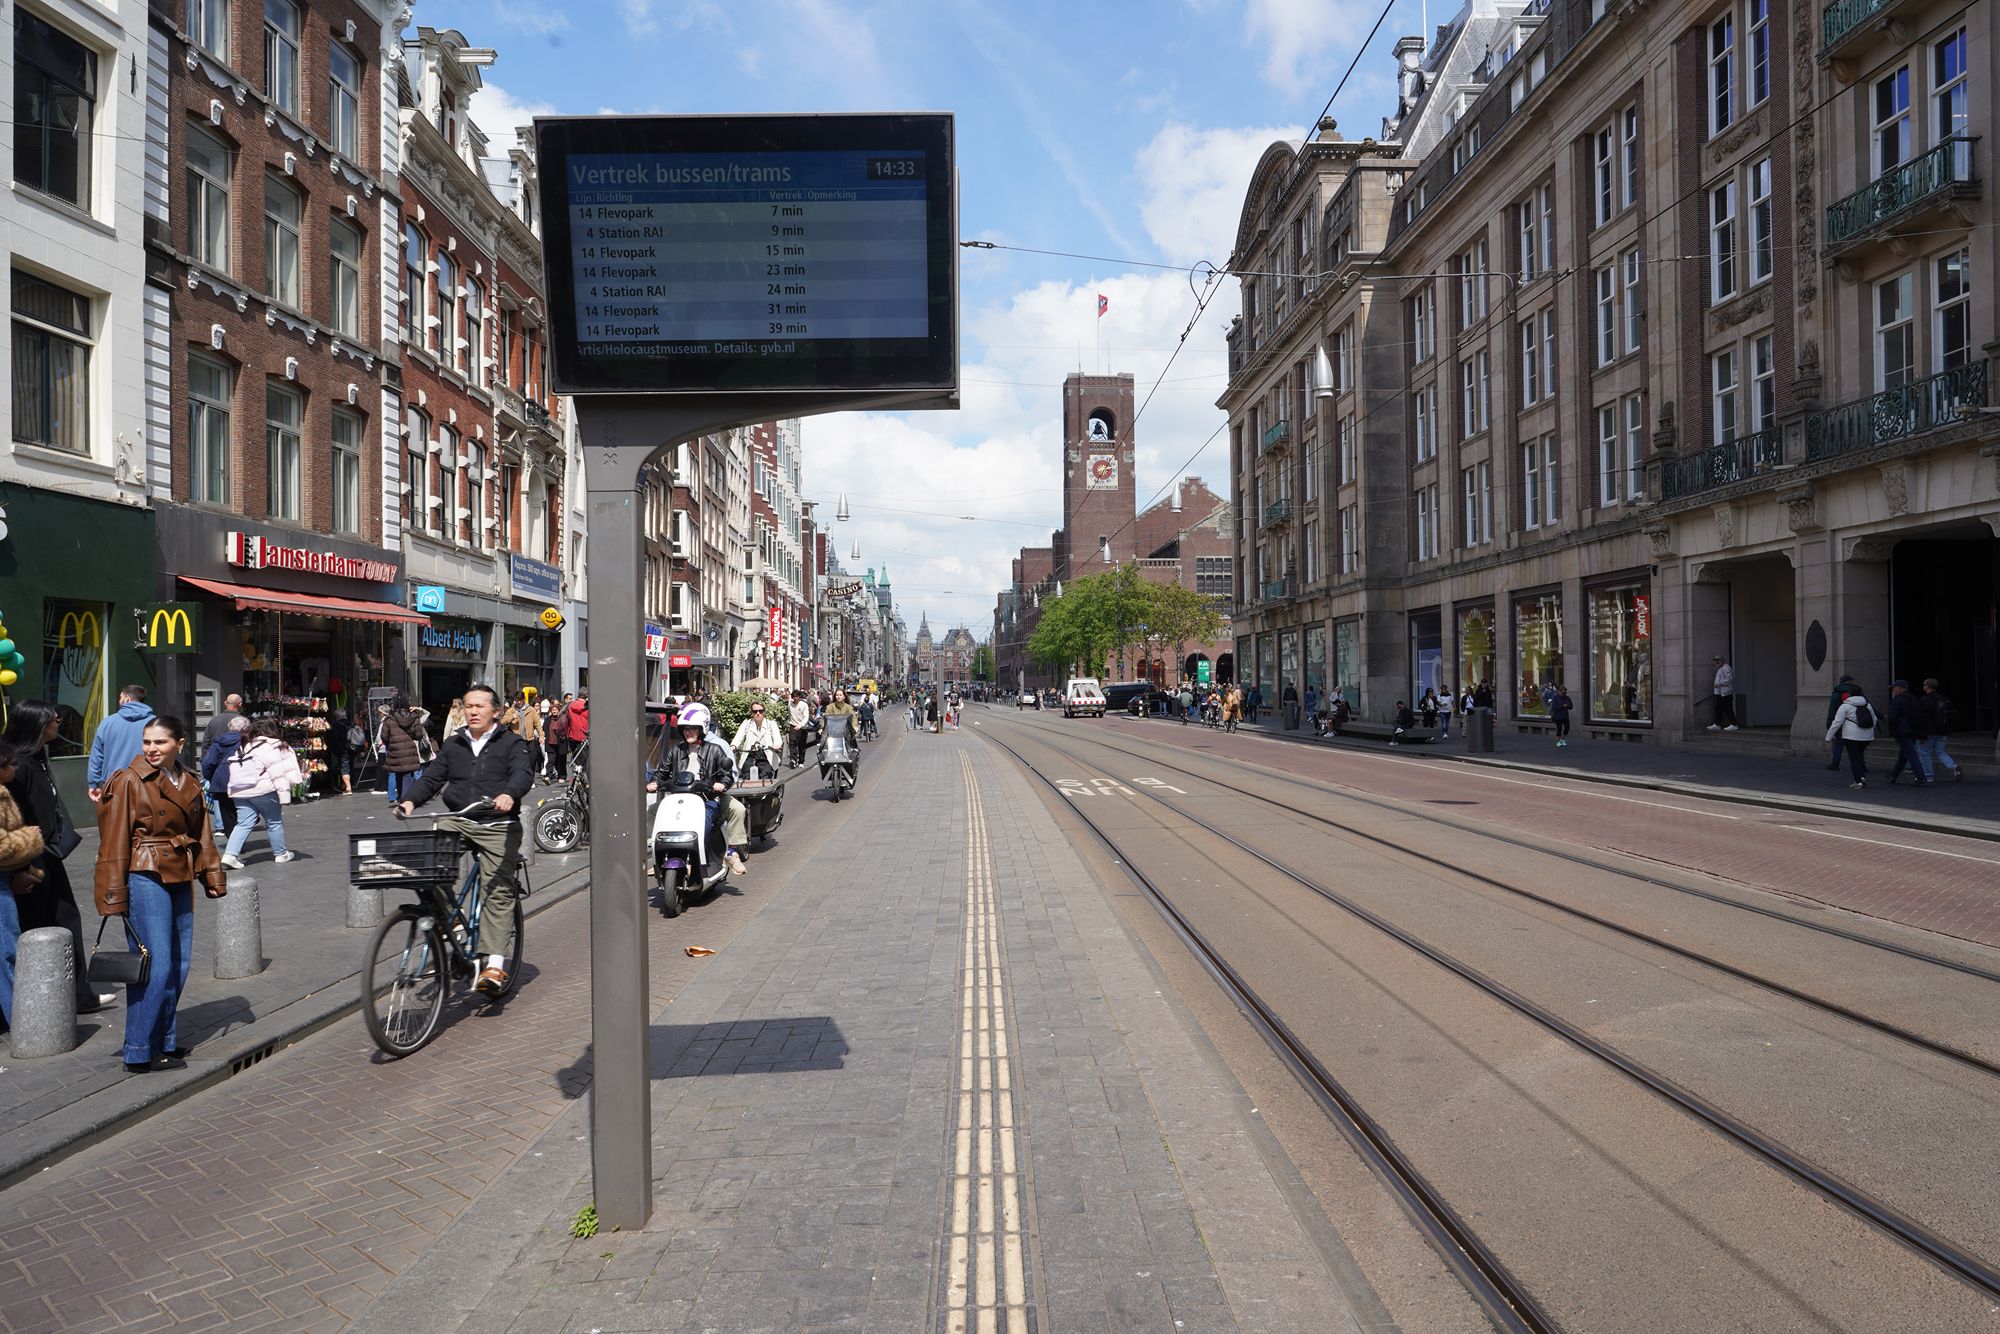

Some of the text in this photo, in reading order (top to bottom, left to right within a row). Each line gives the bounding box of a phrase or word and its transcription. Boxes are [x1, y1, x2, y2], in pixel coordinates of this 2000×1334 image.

[572, 162, 792, 184] Vertrek bussen/trams
[874, 162, 915, 176] 14:33
[576, 190, 856, 204] Lijn Richting Vertrek Opmerking
[579, 204, 803, 220] 14 Flevopark 7 min
[586, 224, 804, 238] 4 Station RAI 9 min
[582, 244, 804, 260] 14 Flevopark 15 min
[583, 264, 805, 280] 14 Flevopark 23 min
[590, 283, 806, 298] 4 Station RAI 24 min
[585, 303, 806, 319] 14 Flevopark 31 min
[587, 322, 807, 338] 14 Flevopark 39 min
[714, 342, 757, 354] Details:
[760, 342, 795, 356] gvb.nl
[268, 545, 398, 584] amsterdam TODAY
[828, 584, 859, 596] CASINO
[422, 626, 475, 654] Albert Heijn
